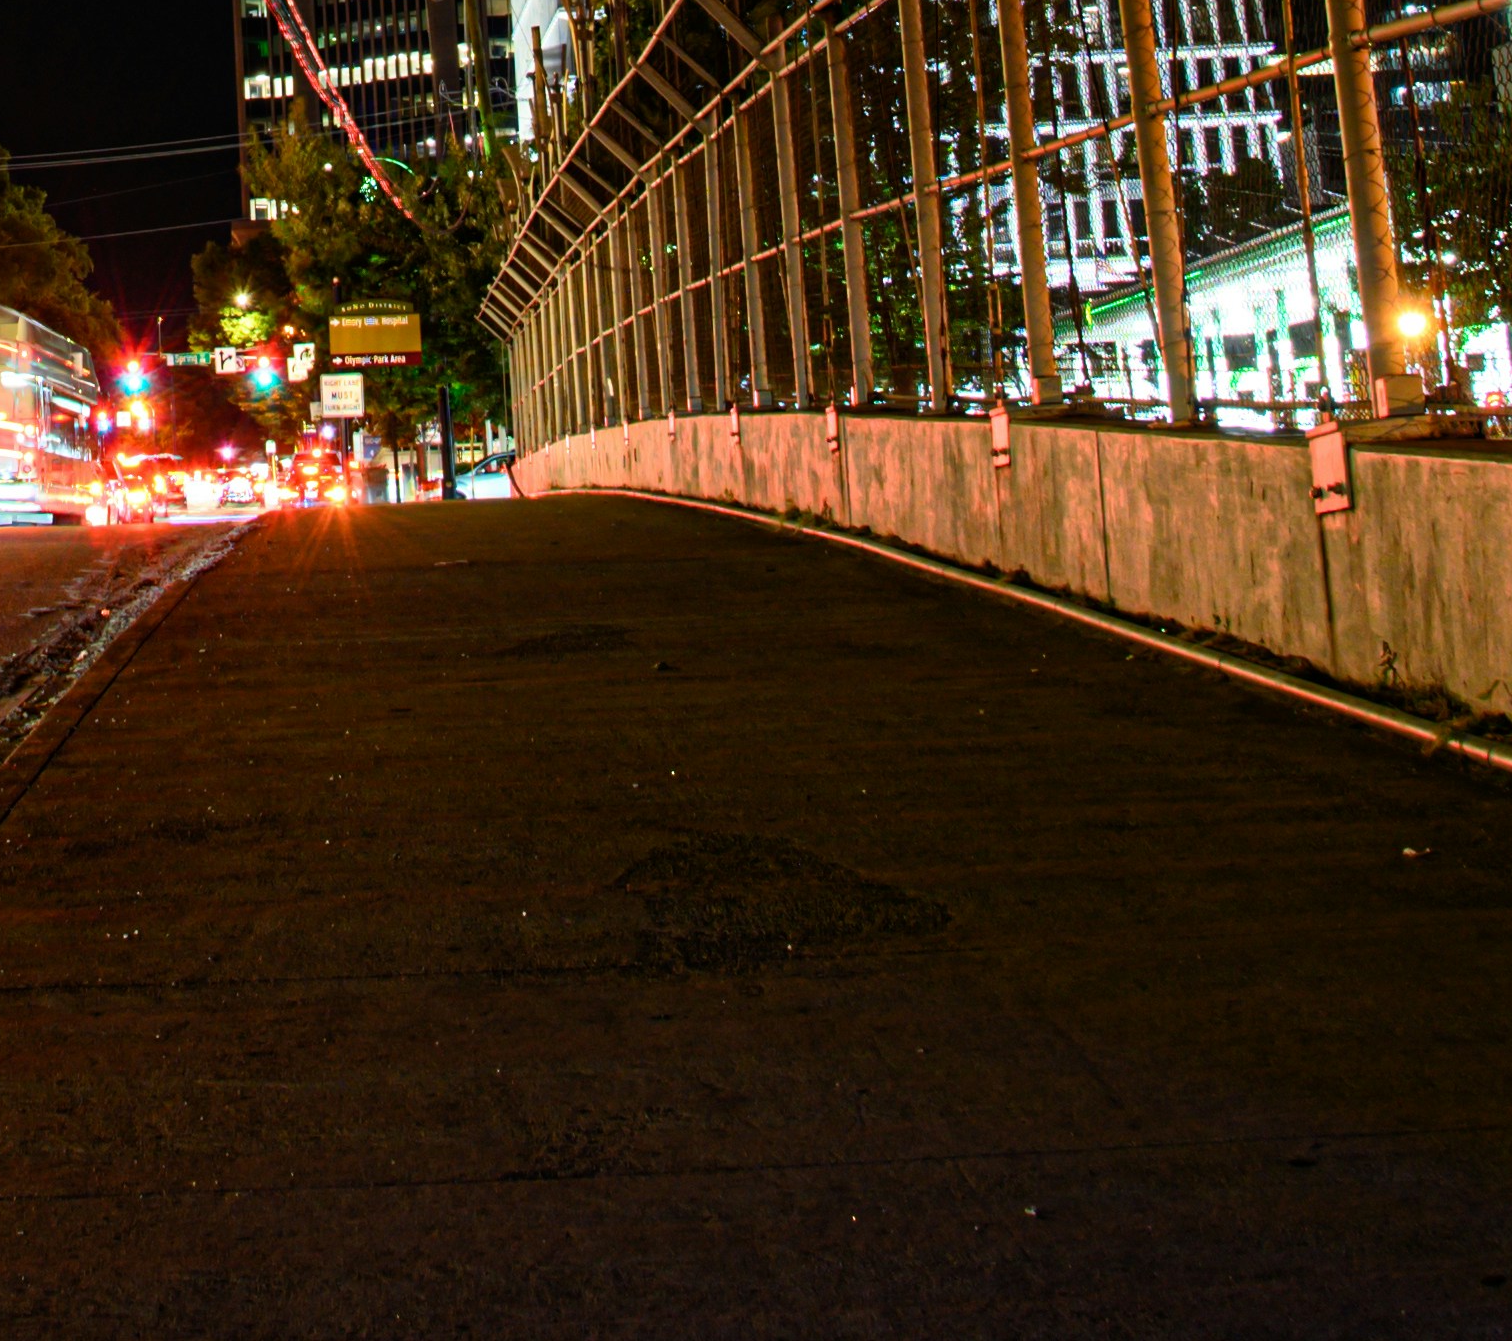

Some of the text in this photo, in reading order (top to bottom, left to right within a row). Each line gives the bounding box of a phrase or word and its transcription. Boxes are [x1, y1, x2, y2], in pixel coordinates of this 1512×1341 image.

[341, 316, 362, 328] Emory
[381, 315, 408, 327] Hospital
[175, 354, 197, 365] Spring
[344, 354, 406, 366] Olympic Park Area
[332, 391, 353, 399] MUST
